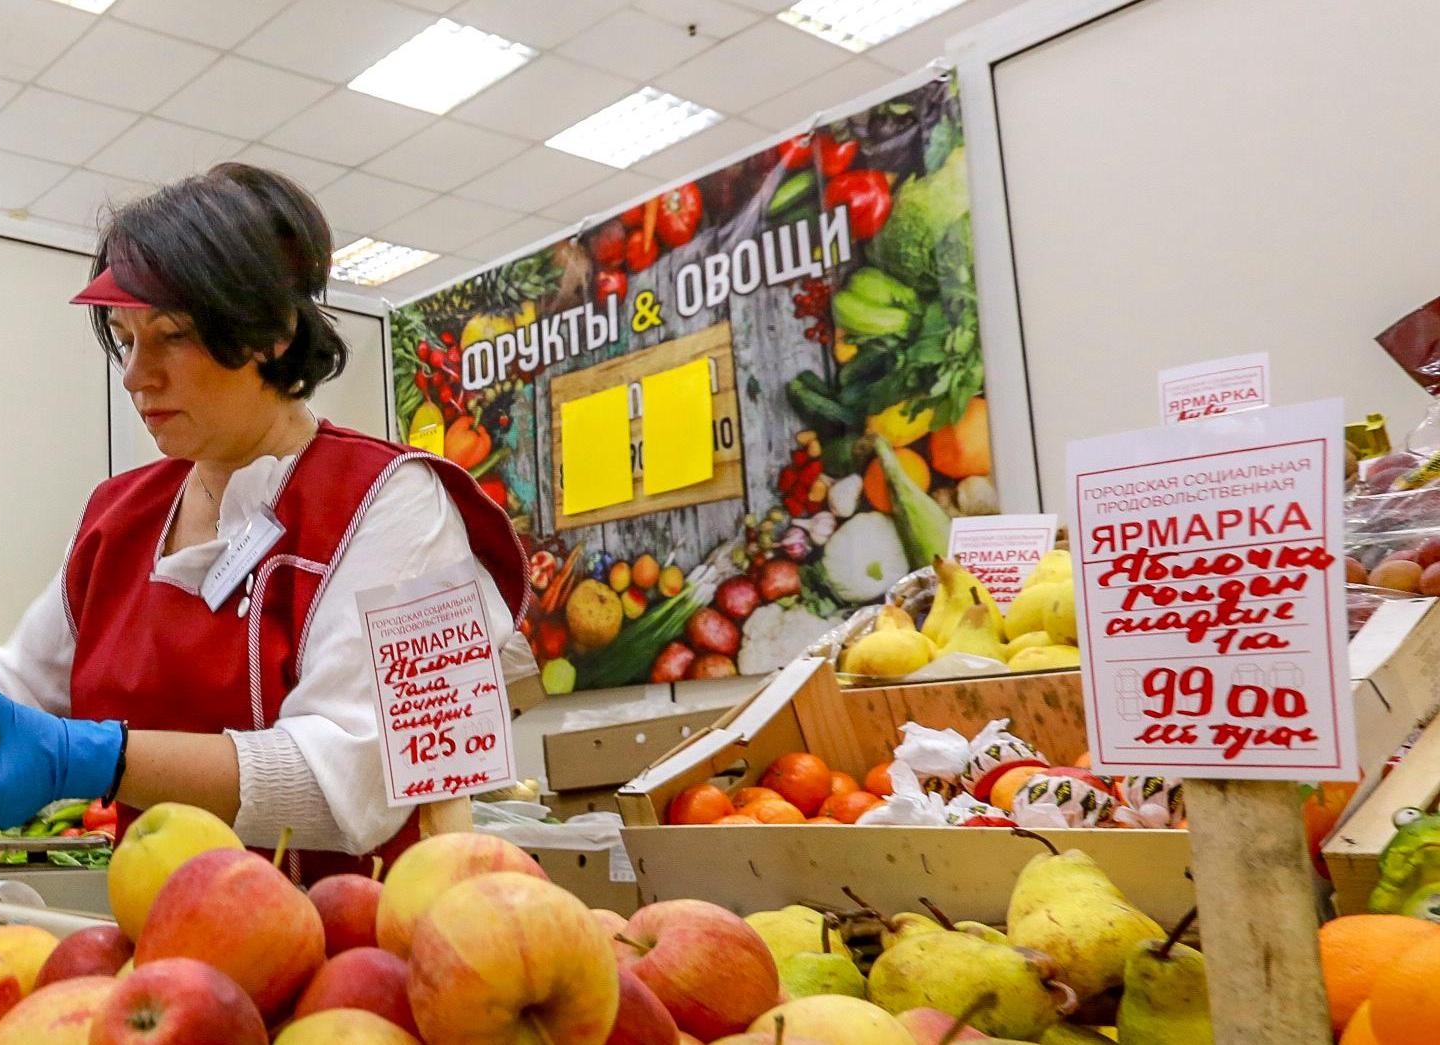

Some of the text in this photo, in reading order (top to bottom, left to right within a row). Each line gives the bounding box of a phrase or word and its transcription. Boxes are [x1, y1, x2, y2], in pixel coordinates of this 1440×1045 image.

[461, 204, 851, 391] ФРУКТЫ & ОВОЩИ
[1168, 387, 1259, 412] ЯРМАРКА
[1084, 458, 1311, 501] ГОРОДСКАЯ СОЦИАЛЬНАЯ
[1097, 477, 1296, 515] ПРОДОВОЛЬСТВЕННАЯ
[1091, 501, 1313, 555] ЯРМАРКА
[379, 620, 484, 663] ЯРМАРКА
[400, 727, 456, 768] 125
